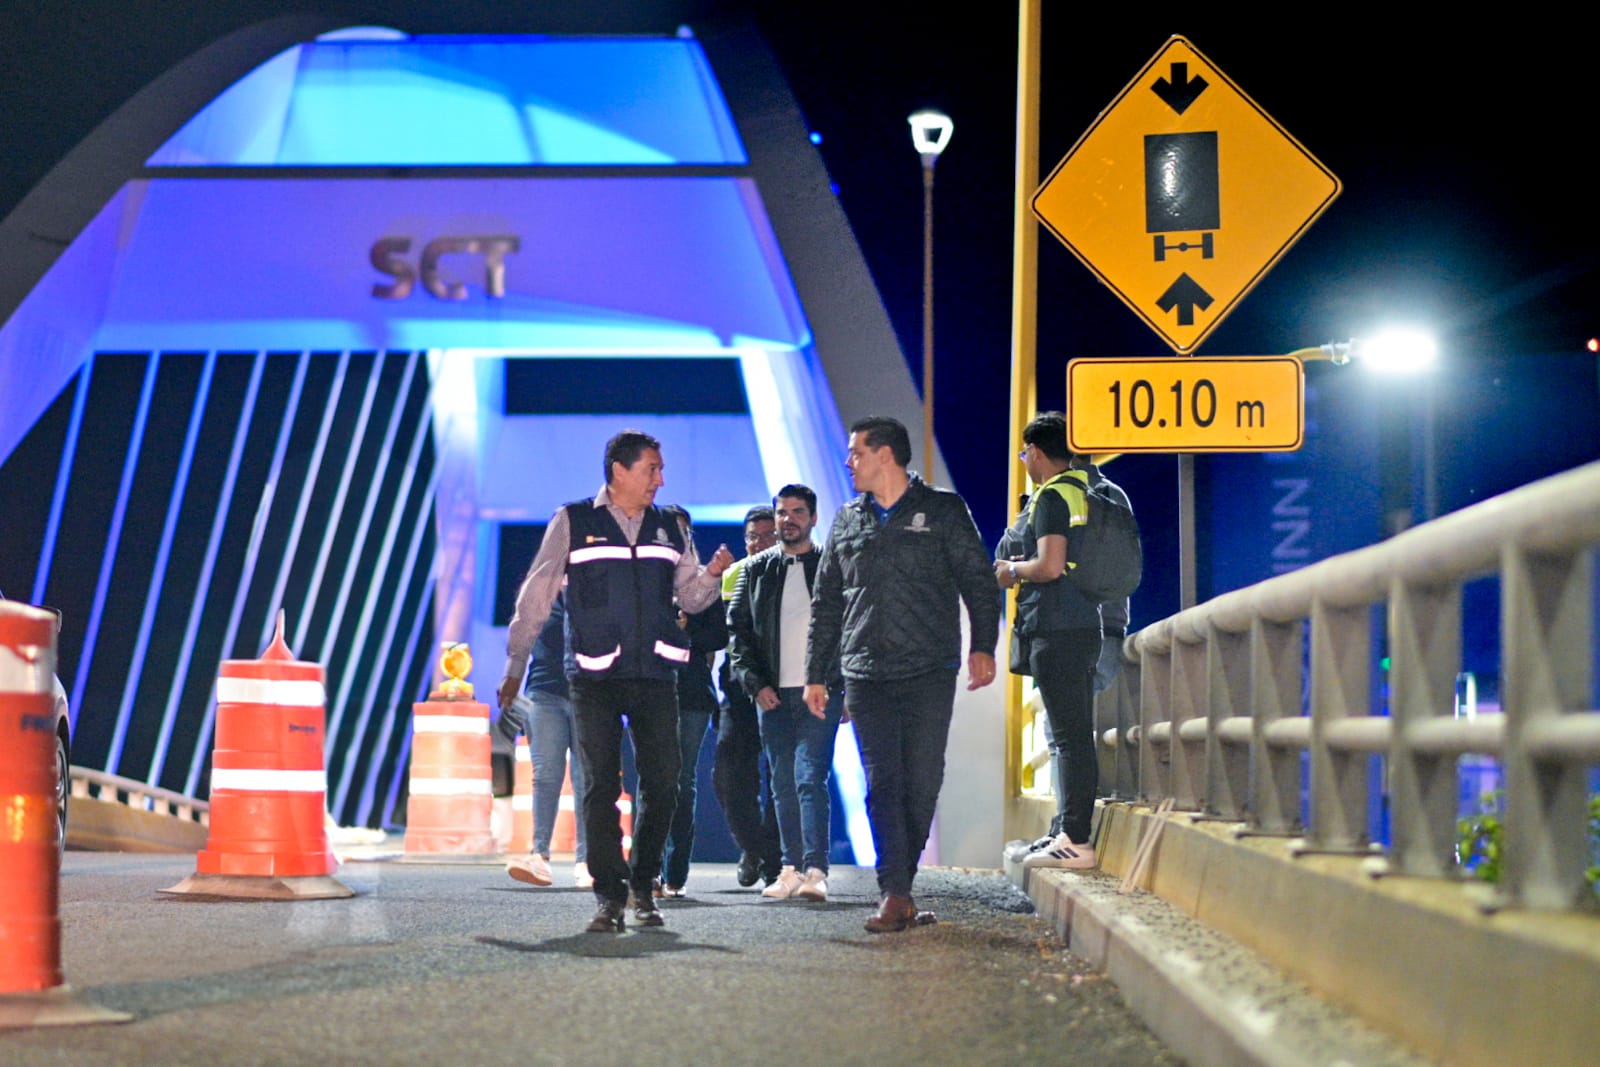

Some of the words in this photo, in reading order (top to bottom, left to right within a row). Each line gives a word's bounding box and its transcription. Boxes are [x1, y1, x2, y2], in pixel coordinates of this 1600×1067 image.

[369, 235, 521, 301] SCT
[1108, 378, 1218, 429] 10.10
[1236, 400, 1265, 429] m
